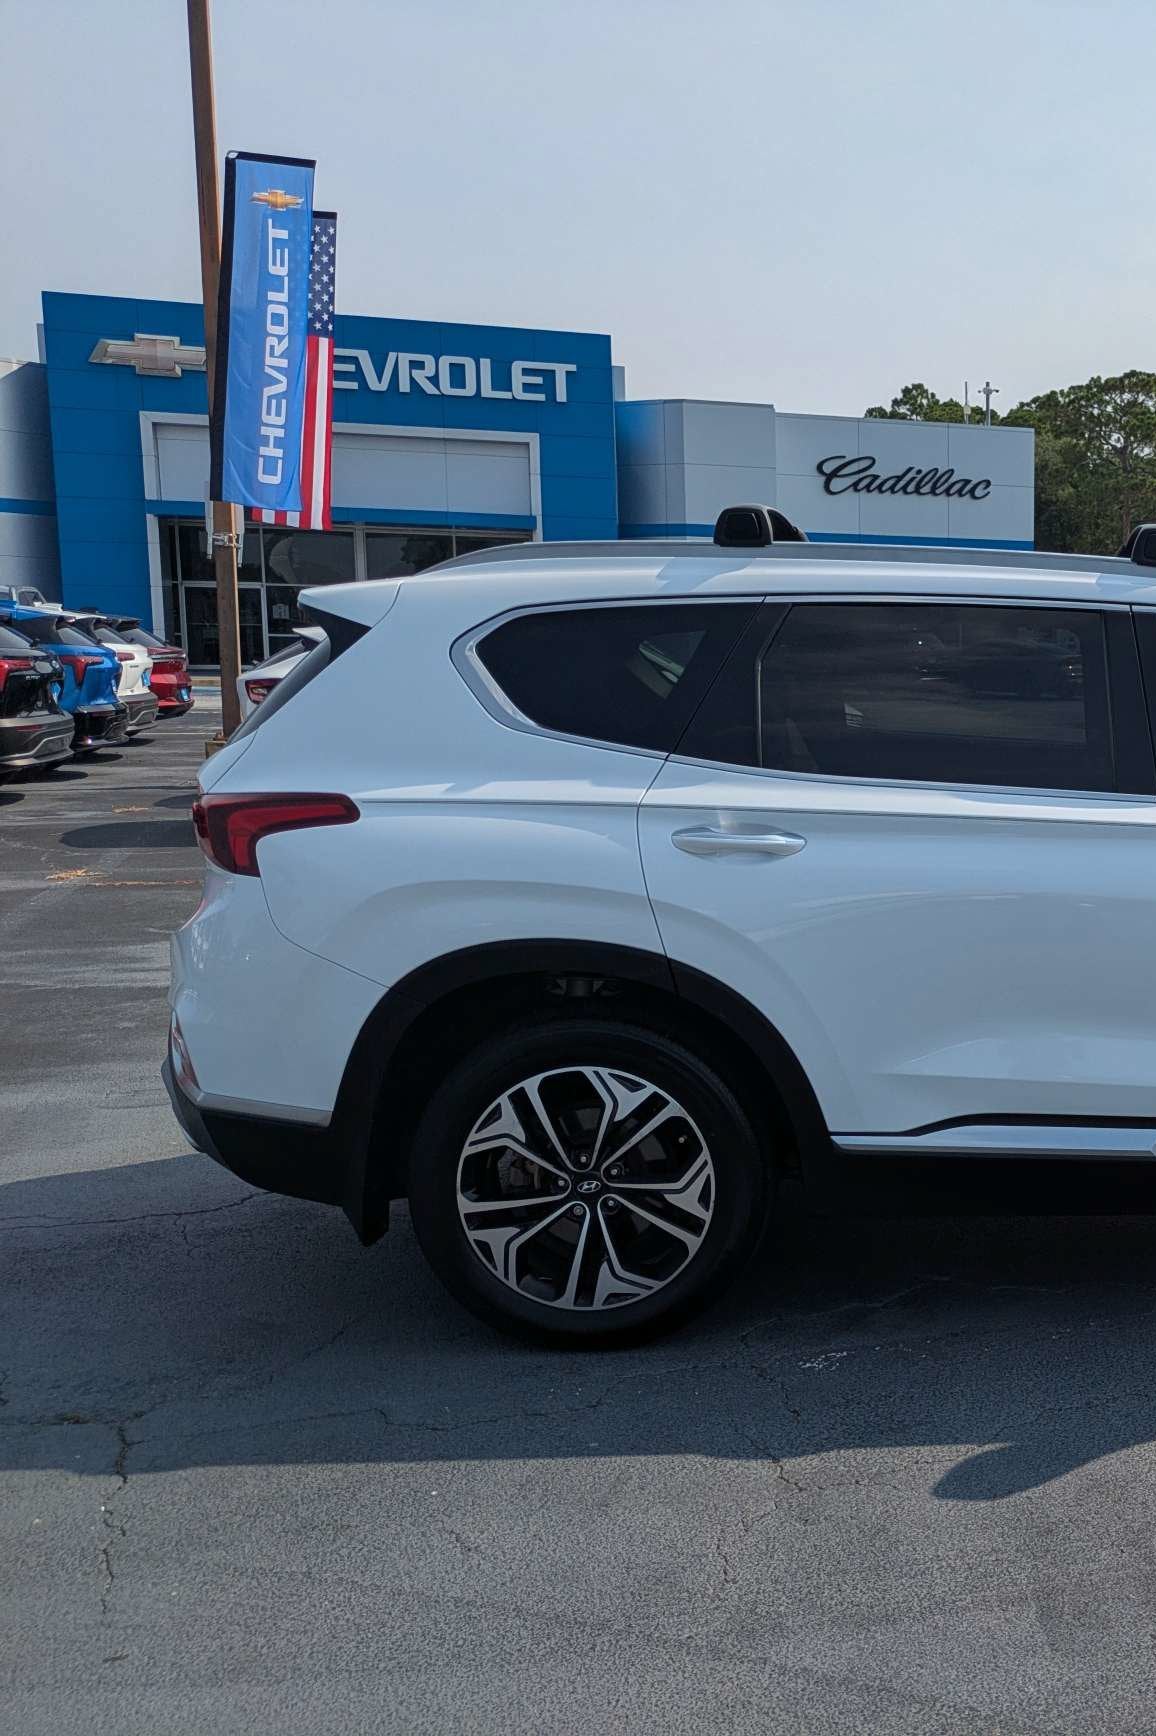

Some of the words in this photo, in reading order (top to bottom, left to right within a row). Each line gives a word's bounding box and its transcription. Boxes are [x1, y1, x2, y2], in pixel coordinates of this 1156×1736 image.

[257, 218, 289, 485] CHEVROLET
[333, 347, 577, 403] EVROLET
[816, 455, 992, 501] Cadillac
